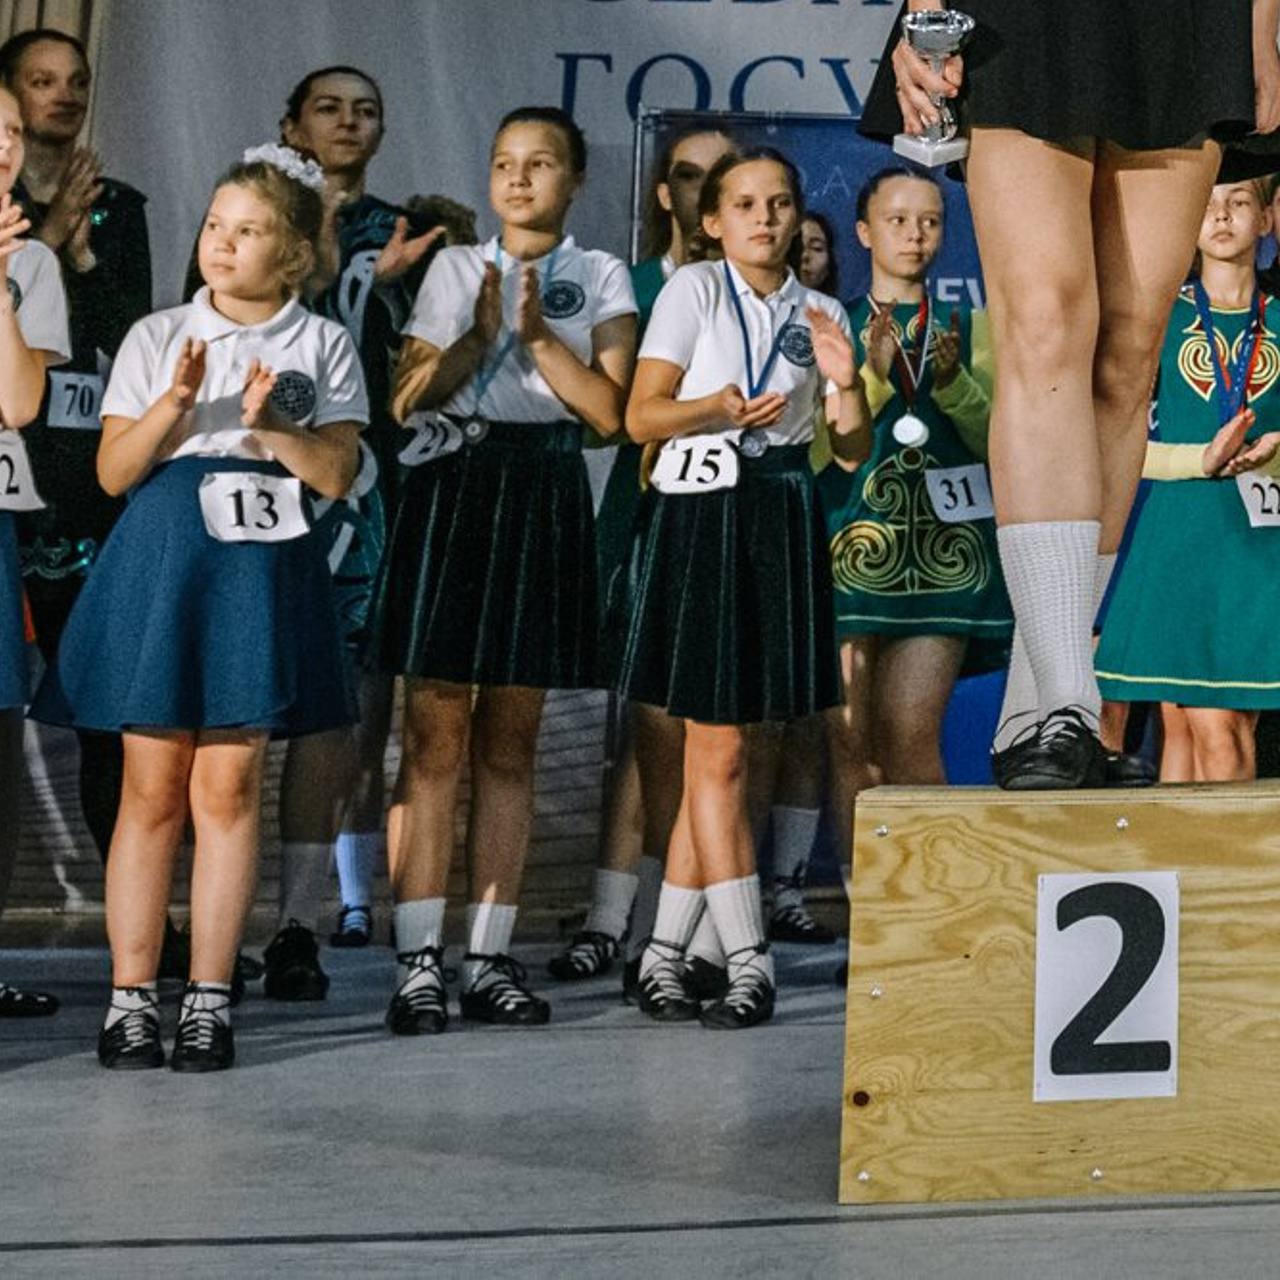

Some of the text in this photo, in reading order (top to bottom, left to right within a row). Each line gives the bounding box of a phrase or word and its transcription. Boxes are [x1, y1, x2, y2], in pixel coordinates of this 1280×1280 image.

[64, 384, 95, 418] 70
[0, 453, 20, 495] 2
[675, 447, 722, 485] 15
[226, 488, 279, 530] 13
[943, 475, 978, 511] 31
[1048, 880, 1172, 1076] 2
